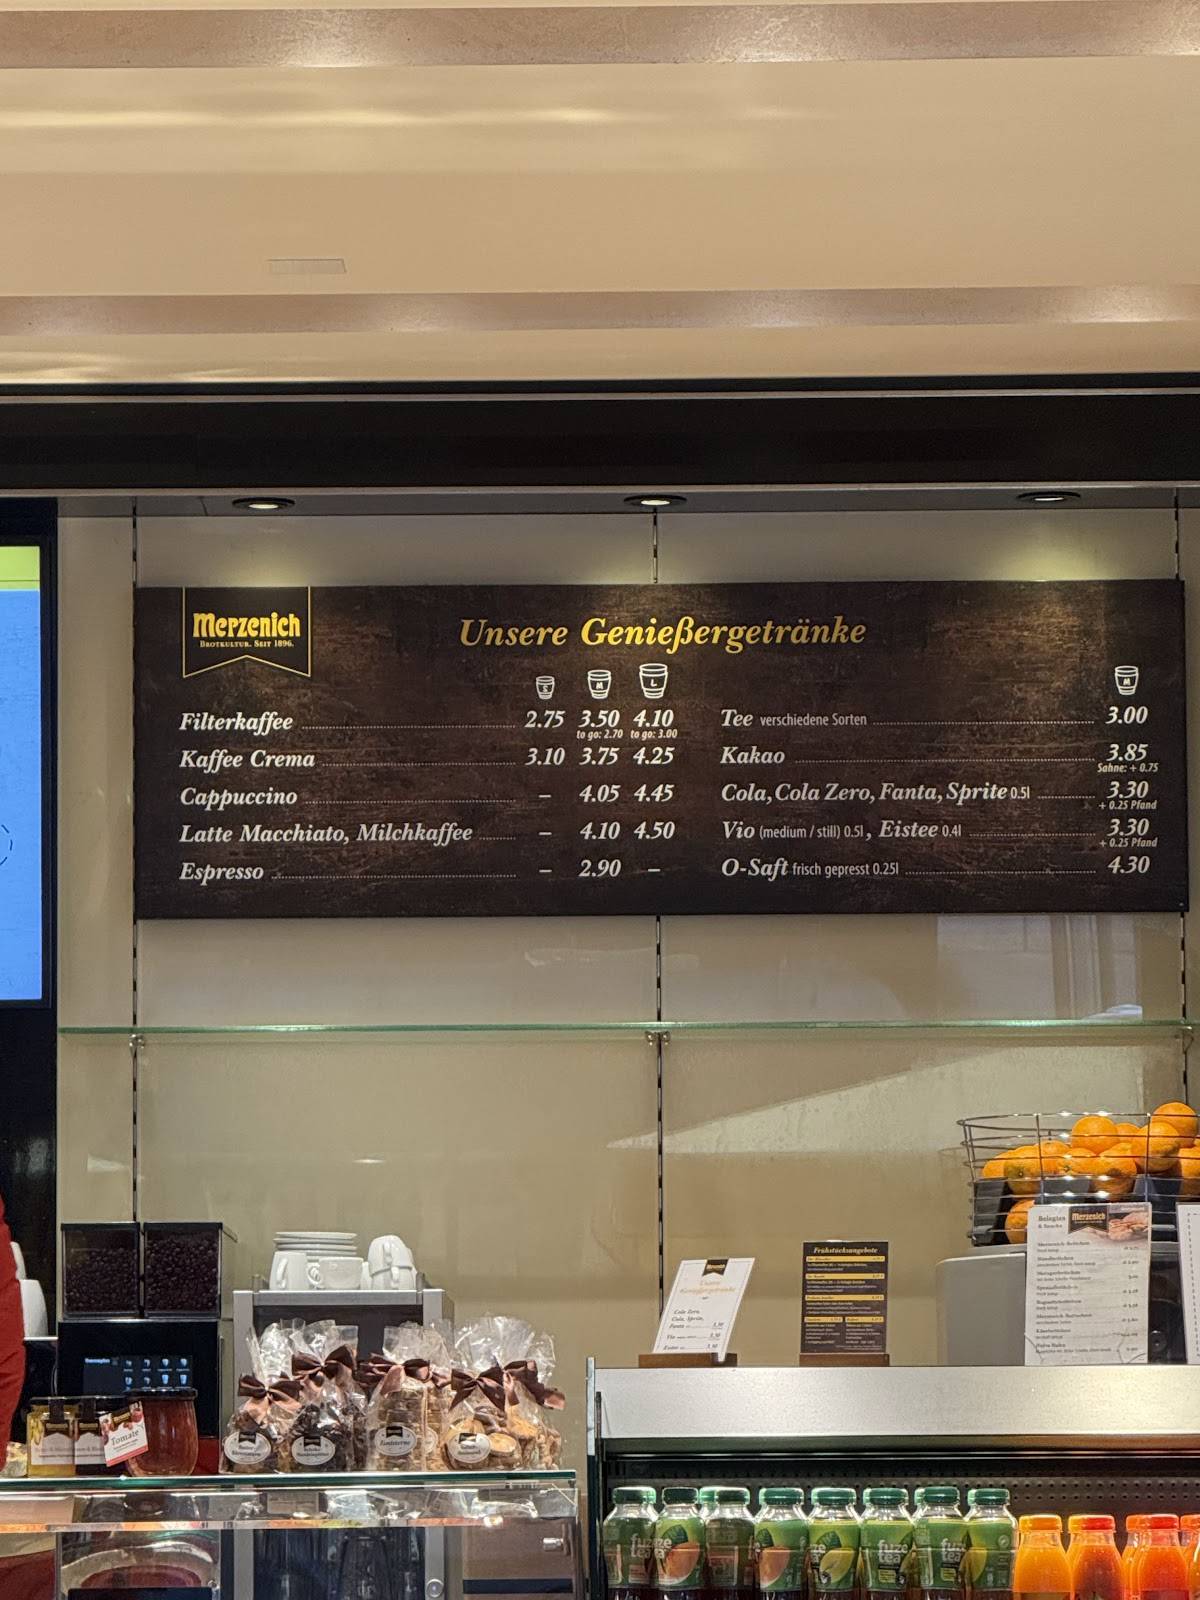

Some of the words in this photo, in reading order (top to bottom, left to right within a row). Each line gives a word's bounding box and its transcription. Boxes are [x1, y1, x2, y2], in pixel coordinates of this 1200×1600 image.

[193, 612, 300, 637] Merzenich
[461, 620, 568, 645] Unsere
[581, 616, 865, 654] Genießergetränke
[179, 712, 293, 736] Filterkaffee
[525, 710, 565, 728] 2.75
[579, 710, 620, 727] 3.50
[633, 710, 674, 727] 4.10
[721, 710, 753, 726] Tee
[760, 713, 828, 726] verschiedene
[832, 713, 866, 725] Sorten
[1106, 706, 1148, 724] 3.00
[577, 730, 585, 738] to
[588, 730, 602, 740] go:
[604, 730, 623, 738] 2.70
[630, 730, 639, 738] to
[642, 730, 656, 740] go:
[658, 730, 677, 738] 3.00
[180, 749, 243, 773] Kaffee
[251, 750, 315, 767] Crema
[526, 748, 565, 765] 3.10
[580, 747, 619, 765] 3.75
[633, 747, 675, 764] 4.25
[720, 746, 785, 763] Kakao
[1107, 744, 1148, 761] 3.85
[1097, 763, 1127, 773] Sahne:
[1139, 764, 1158, 773] 0.75
[180, 787, 298, 811] Cappuccino
[579, 785, 620, 802] 4.05
[633, 784, 674, 802] 4.45
[721, 784, 773, 804] Cola,
[774, 784, 820, 801] Cola
[824, 784, 875, 804] Zero,
[879, 783, 943, 803] Fanta,
[946, 783, 1007, 805] Sprite
[1107, 781, 1148, 798] 3.30
[1109, 801, 1128, 810] 0.25
[1130, 801, 1157, 810] Pfand
[179, 824, 232, 842] Latte
[239, 824, 350, 845] Macchiato,
[356, 823, 473, 846] Milchkaffee
[580, 822, 620, 839] 4.10
[634, 821, 675, 839] 4.50
[723, 821, 755, 839] Vio
[759, 825, 807, 839] (medium
[817, 825, 841, 839] still)
[879, 820, 938, 837] Eistee
[1107, 818, 1149, 836] 3.30
[1110, 838, 1129, 847] 0.25
[1131, 838, 1158, 847] Pfand
[179, 862, 264, 885] Espresso
[579, 860, 621, 877] 2.90
[721, 858, 789, 881] O-Saft
[793, 863, 821, 875] frisch
[825, 865, 870, 878] gepresst
[1108, 856, 1150, 873] 4.30
[878, 1539, 908, 1554] fuze
[878, 1551, 901, 1563] tea
